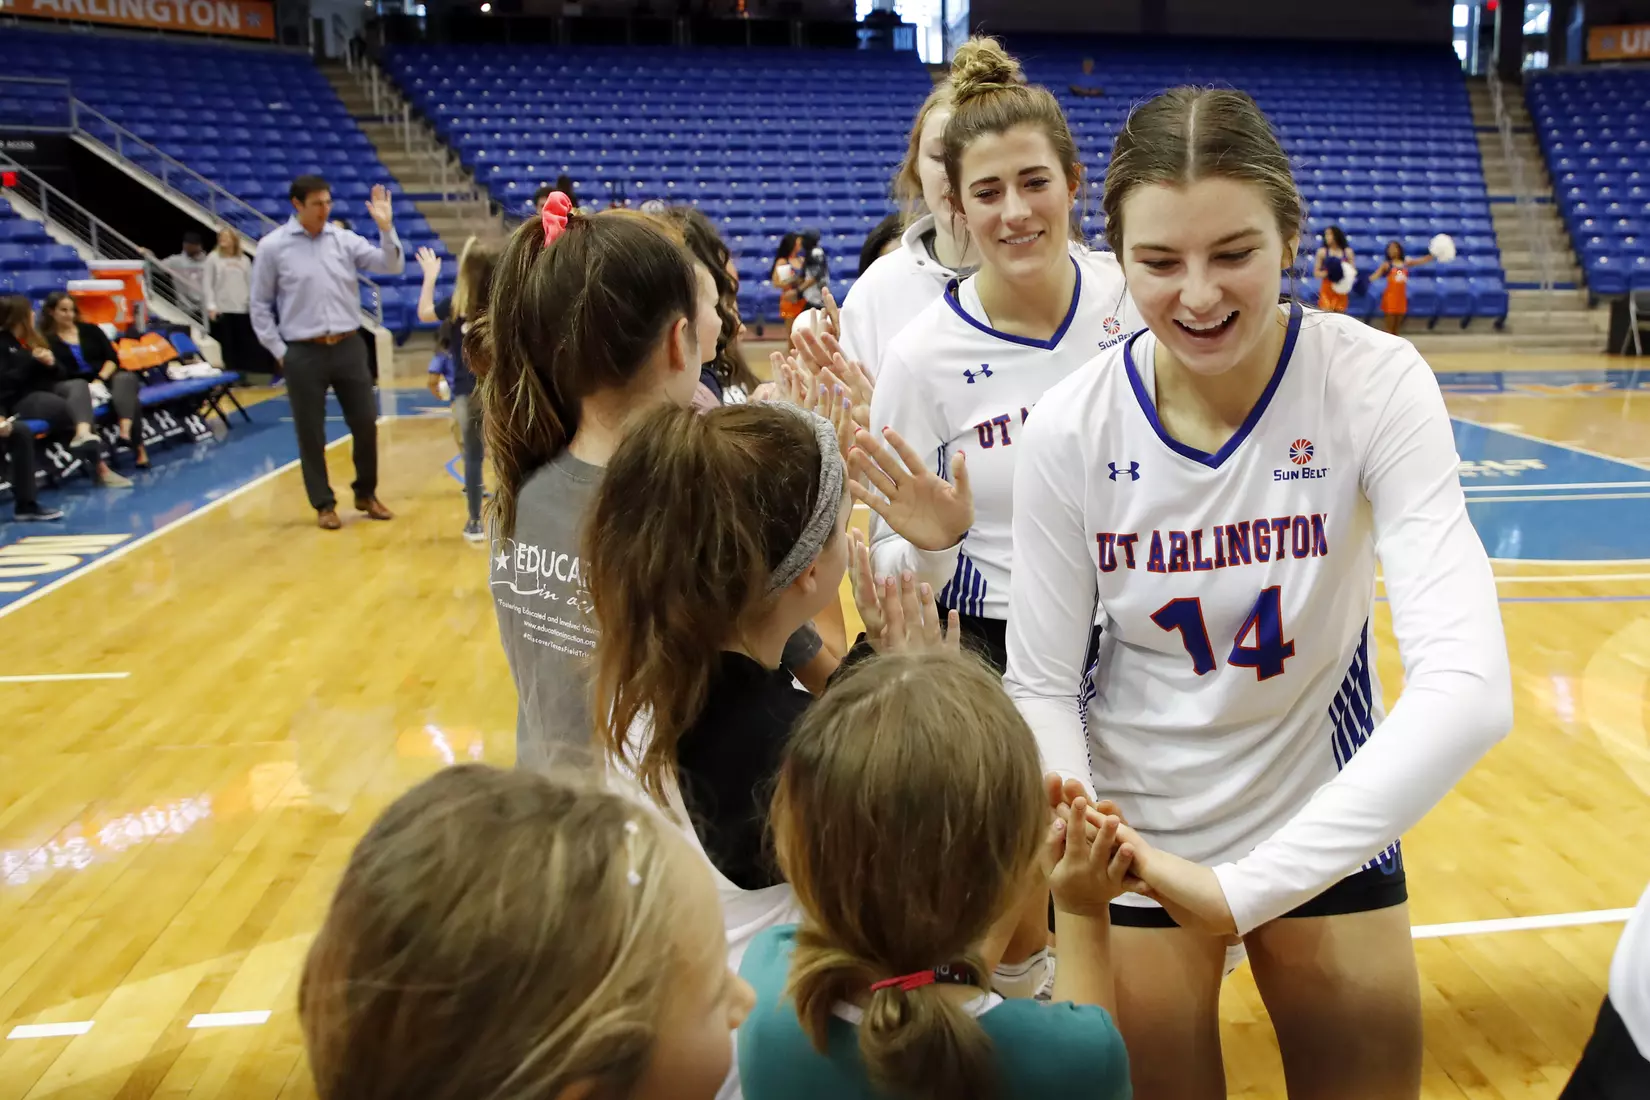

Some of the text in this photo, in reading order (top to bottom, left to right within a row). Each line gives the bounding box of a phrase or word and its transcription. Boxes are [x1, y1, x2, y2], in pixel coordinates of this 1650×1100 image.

[1098, 340, 1118, 351] SUN
[973, 413, 1012, 449] UT
[1273, 467, 1328, 481] SUN BELT
[1096, 513, 1328, 573] UT ARLINGTON
[517, 542, 592, 588] EDUCA
[539, 583, 559, 600] in
[522, 606, 547, 621] Educated
[547, 615, 559, 624] and
[559, 616, 581, 631] Involved
[1150, 585, 1295, 681] 14
